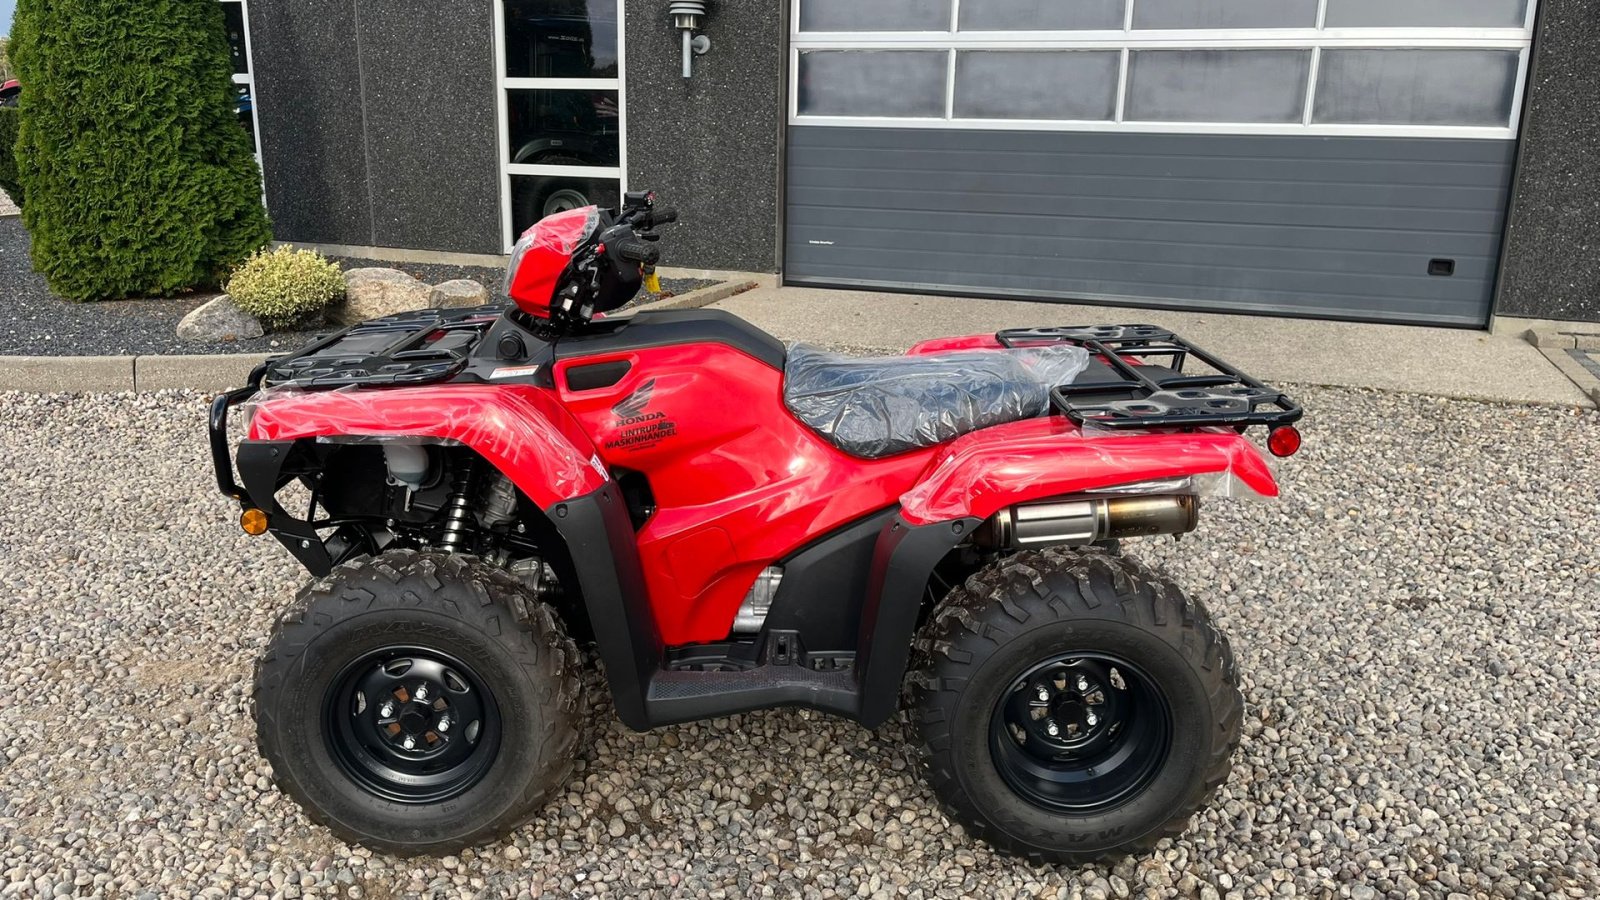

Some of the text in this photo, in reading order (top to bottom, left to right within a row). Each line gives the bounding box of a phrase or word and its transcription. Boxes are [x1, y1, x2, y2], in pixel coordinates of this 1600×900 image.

[616, 411, 666, 427] HONDA
[605, 429, 677, 448] MASKINHANDEL
[620, 424, 658, 437] LINTRUP
